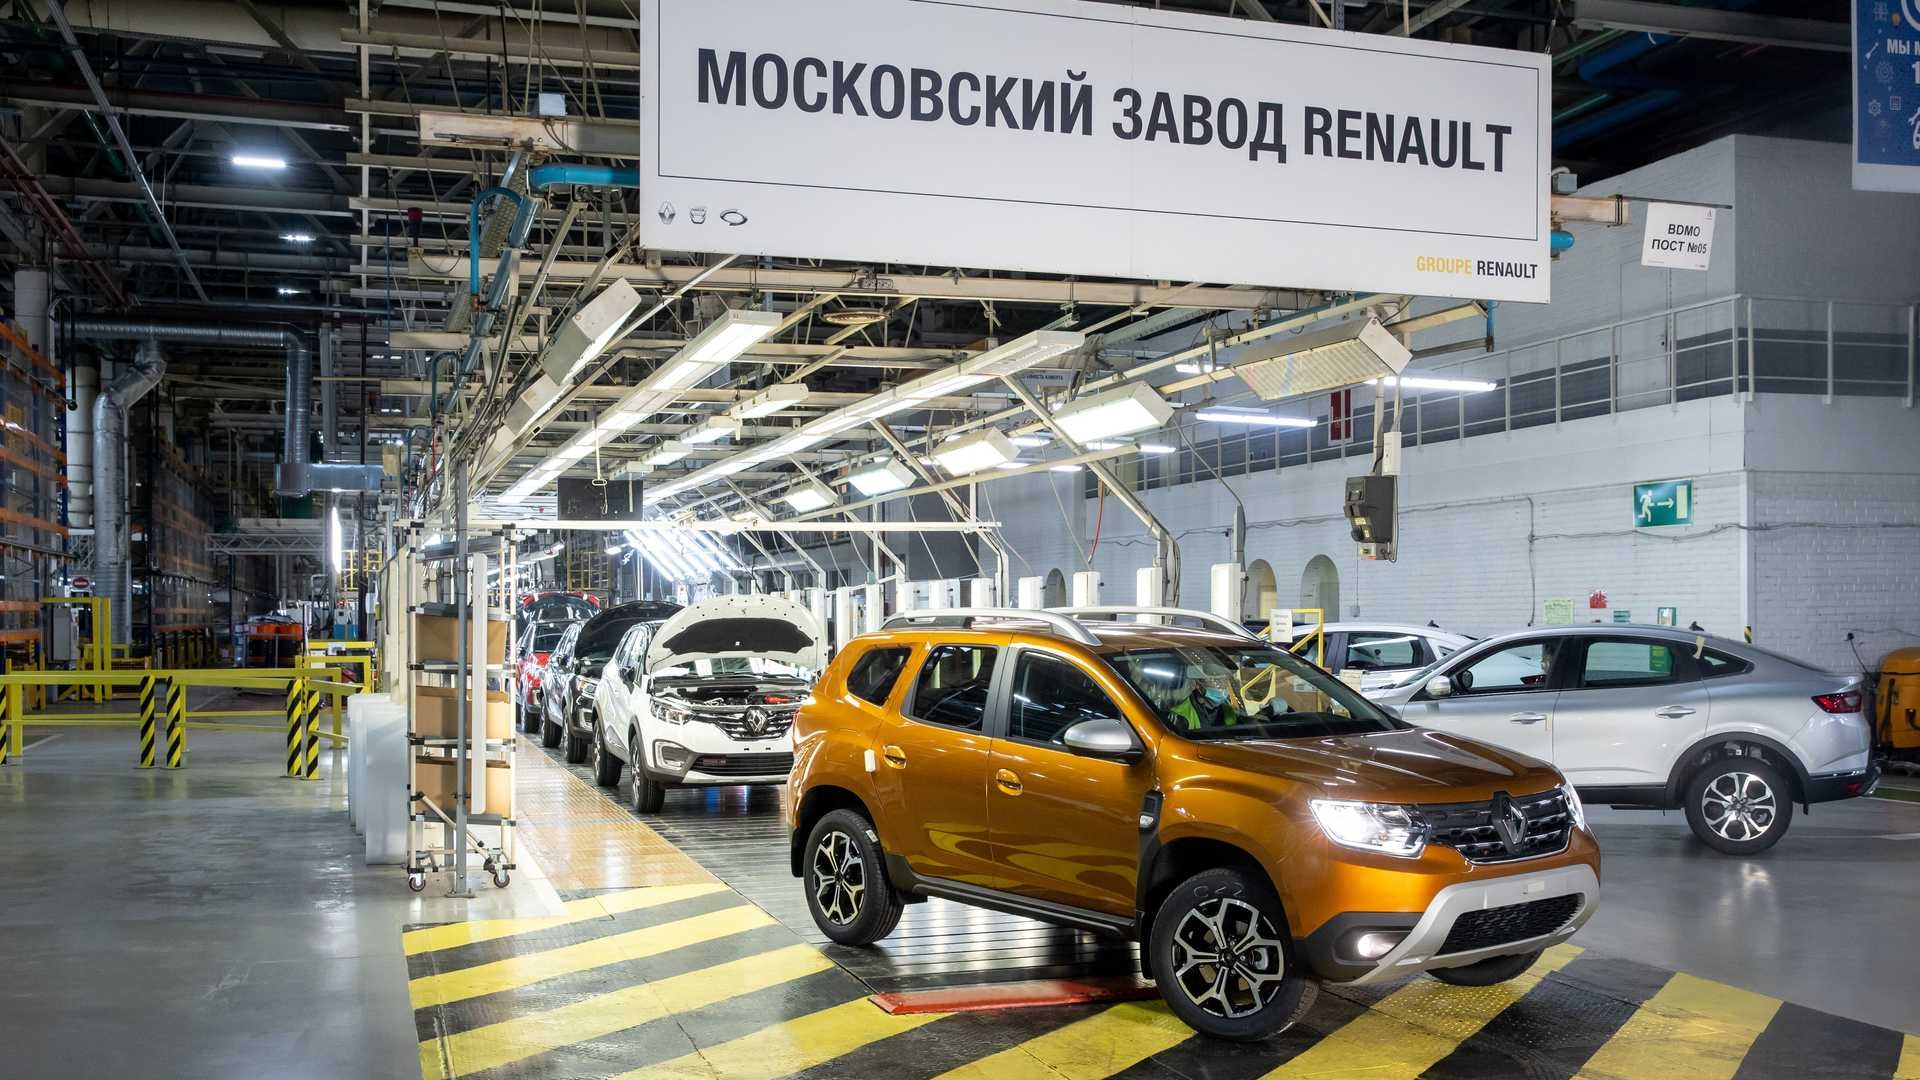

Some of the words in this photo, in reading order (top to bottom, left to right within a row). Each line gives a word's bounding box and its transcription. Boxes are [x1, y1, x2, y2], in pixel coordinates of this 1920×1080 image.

[1887, 39, 1910, 55] МЫ
[698, 47, 1093, 136] МОСКОВСКИЙ
[1112, 87, 1287, 164] ЗАВОД
[1304, 105, 1513, 173] RENAULT
[1652, 239, 1685, 252] ПОСТ
[1687, 242, 1708, 254] №05
[1416, 256, 1472, 274] GROUPE
[1476, 260, 1538, 279] RENAULT
